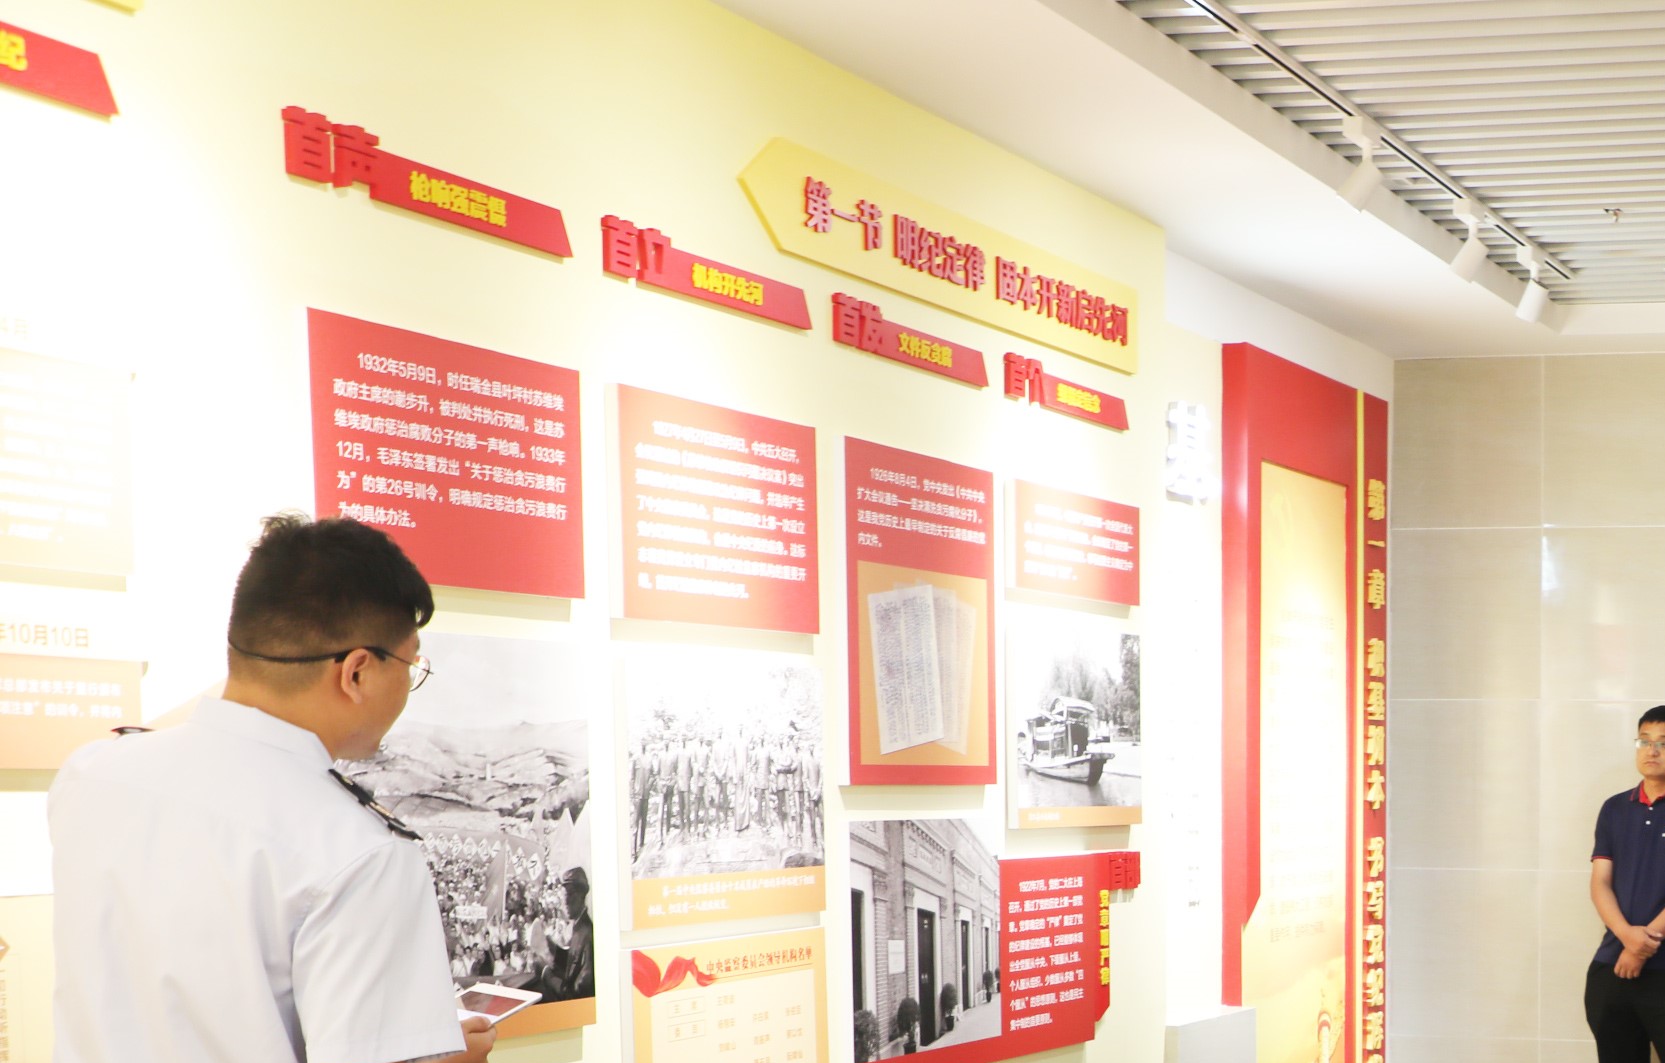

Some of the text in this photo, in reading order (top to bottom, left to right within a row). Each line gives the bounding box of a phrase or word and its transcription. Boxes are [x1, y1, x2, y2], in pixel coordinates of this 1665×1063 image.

[692, 262, 764, 306] 机构开先河
[804, 176, 1129, 346] 第一节 明纪定律 固本开新启先河
[1366, 479, 1386, 609] 第一章
